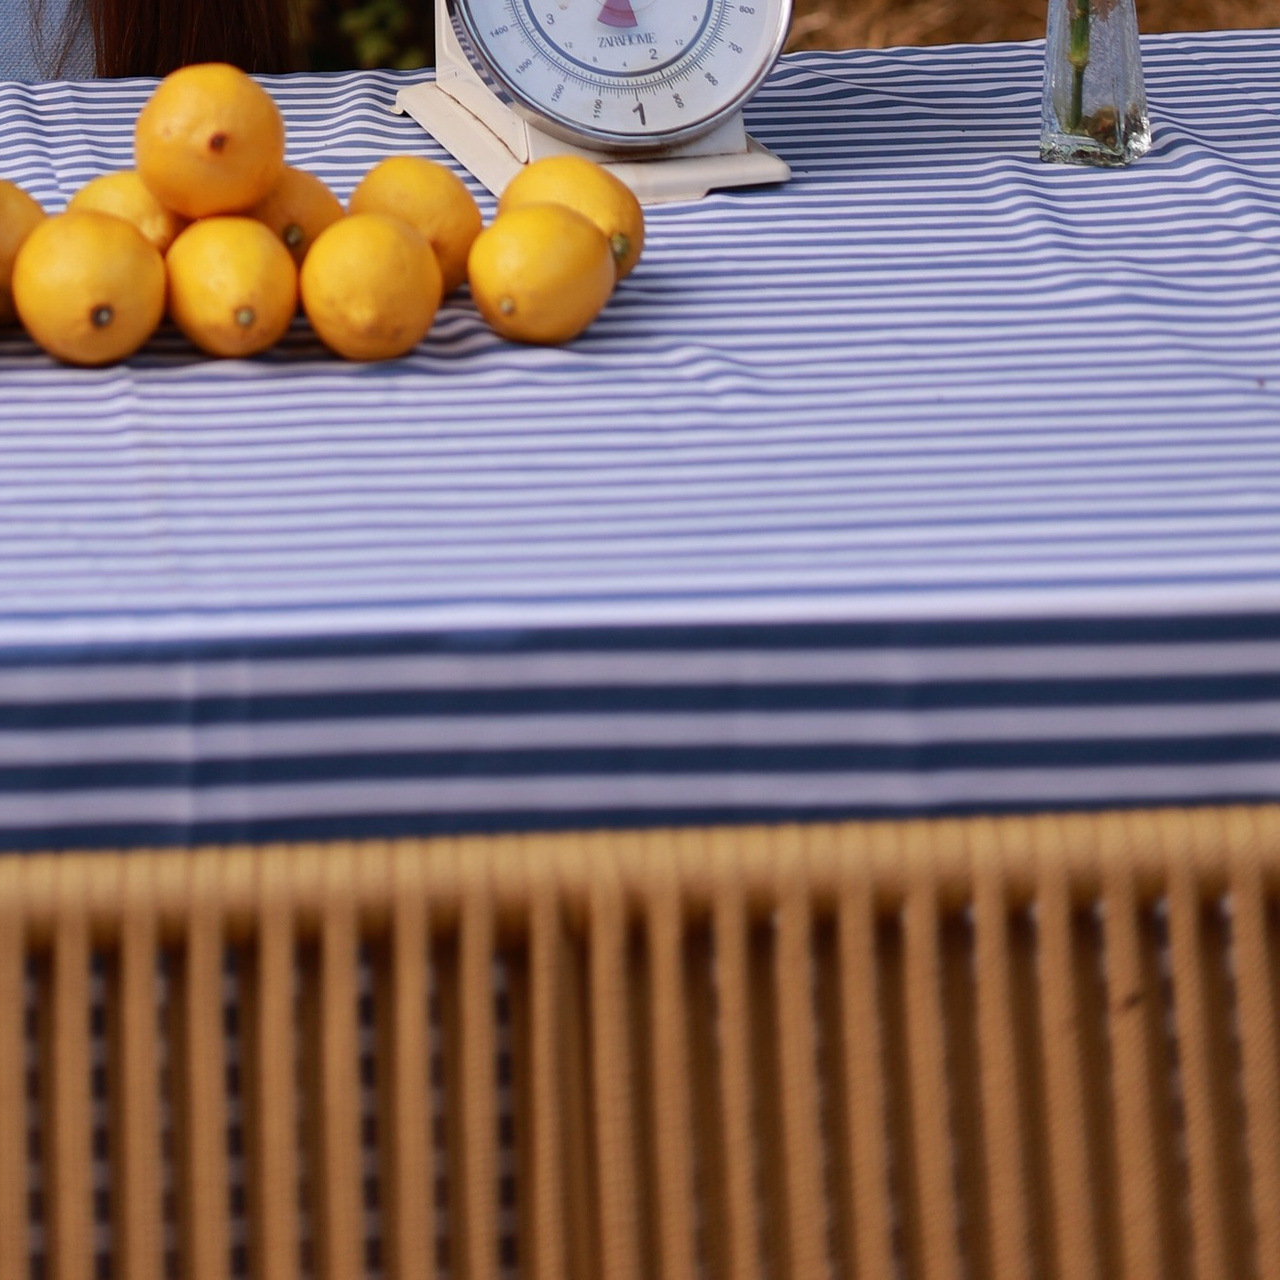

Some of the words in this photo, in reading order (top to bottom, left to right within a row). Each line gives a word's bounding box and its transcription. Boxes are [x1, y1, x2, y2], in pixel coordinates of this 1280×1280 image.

[739, 5, 755, 15] 600
[546, 13, 555, 25] 3
[489, 25, 509, 38] 1400
[649, 48, 658, 60] 2
[728, 42, 743, 54] 700
[515, 58, 533, 75] 1300
[704, 72, 719, 87] 800
[550, 84, 565, 103] 1200
[672, 93, 685, 108] 900
[593, 99, 603, 119] 1100
[632, 102, 646, 126] 1
